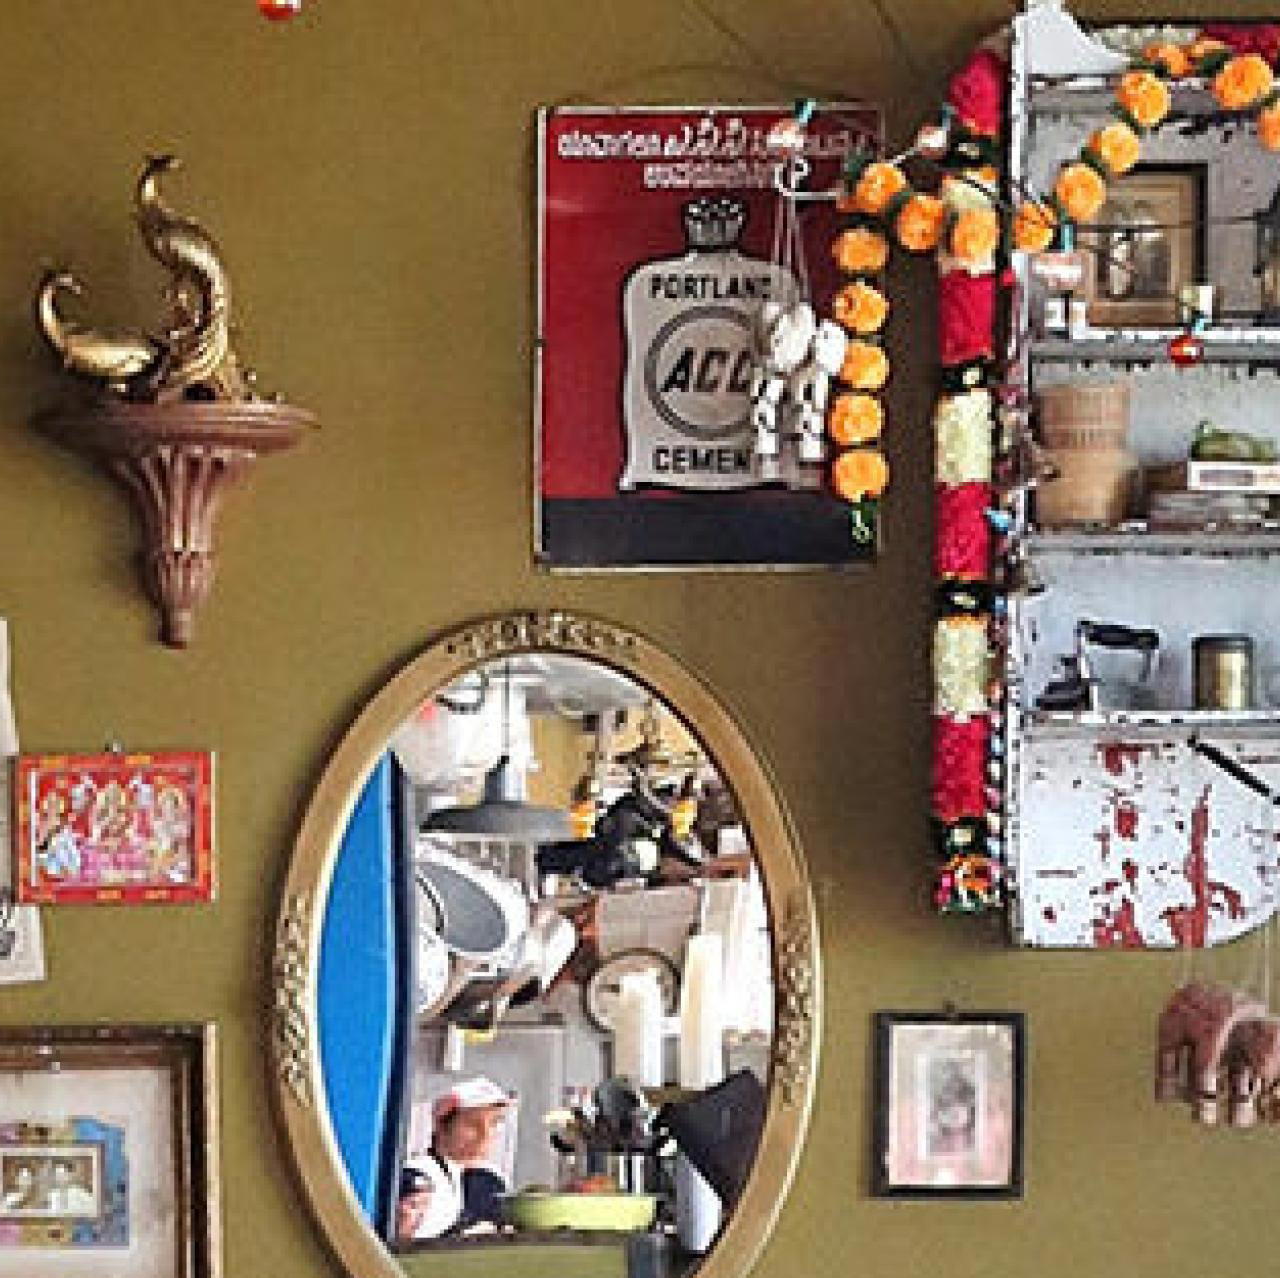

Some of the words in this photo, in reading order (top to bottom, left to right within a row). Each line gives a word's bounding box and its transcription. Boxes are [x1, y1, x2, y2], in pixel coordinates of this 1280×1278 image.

[650, 274, 772, 299] PORTLAND
[661, 347, 754, 393] ACC
[652, 445, 751, 474] CEMEN
